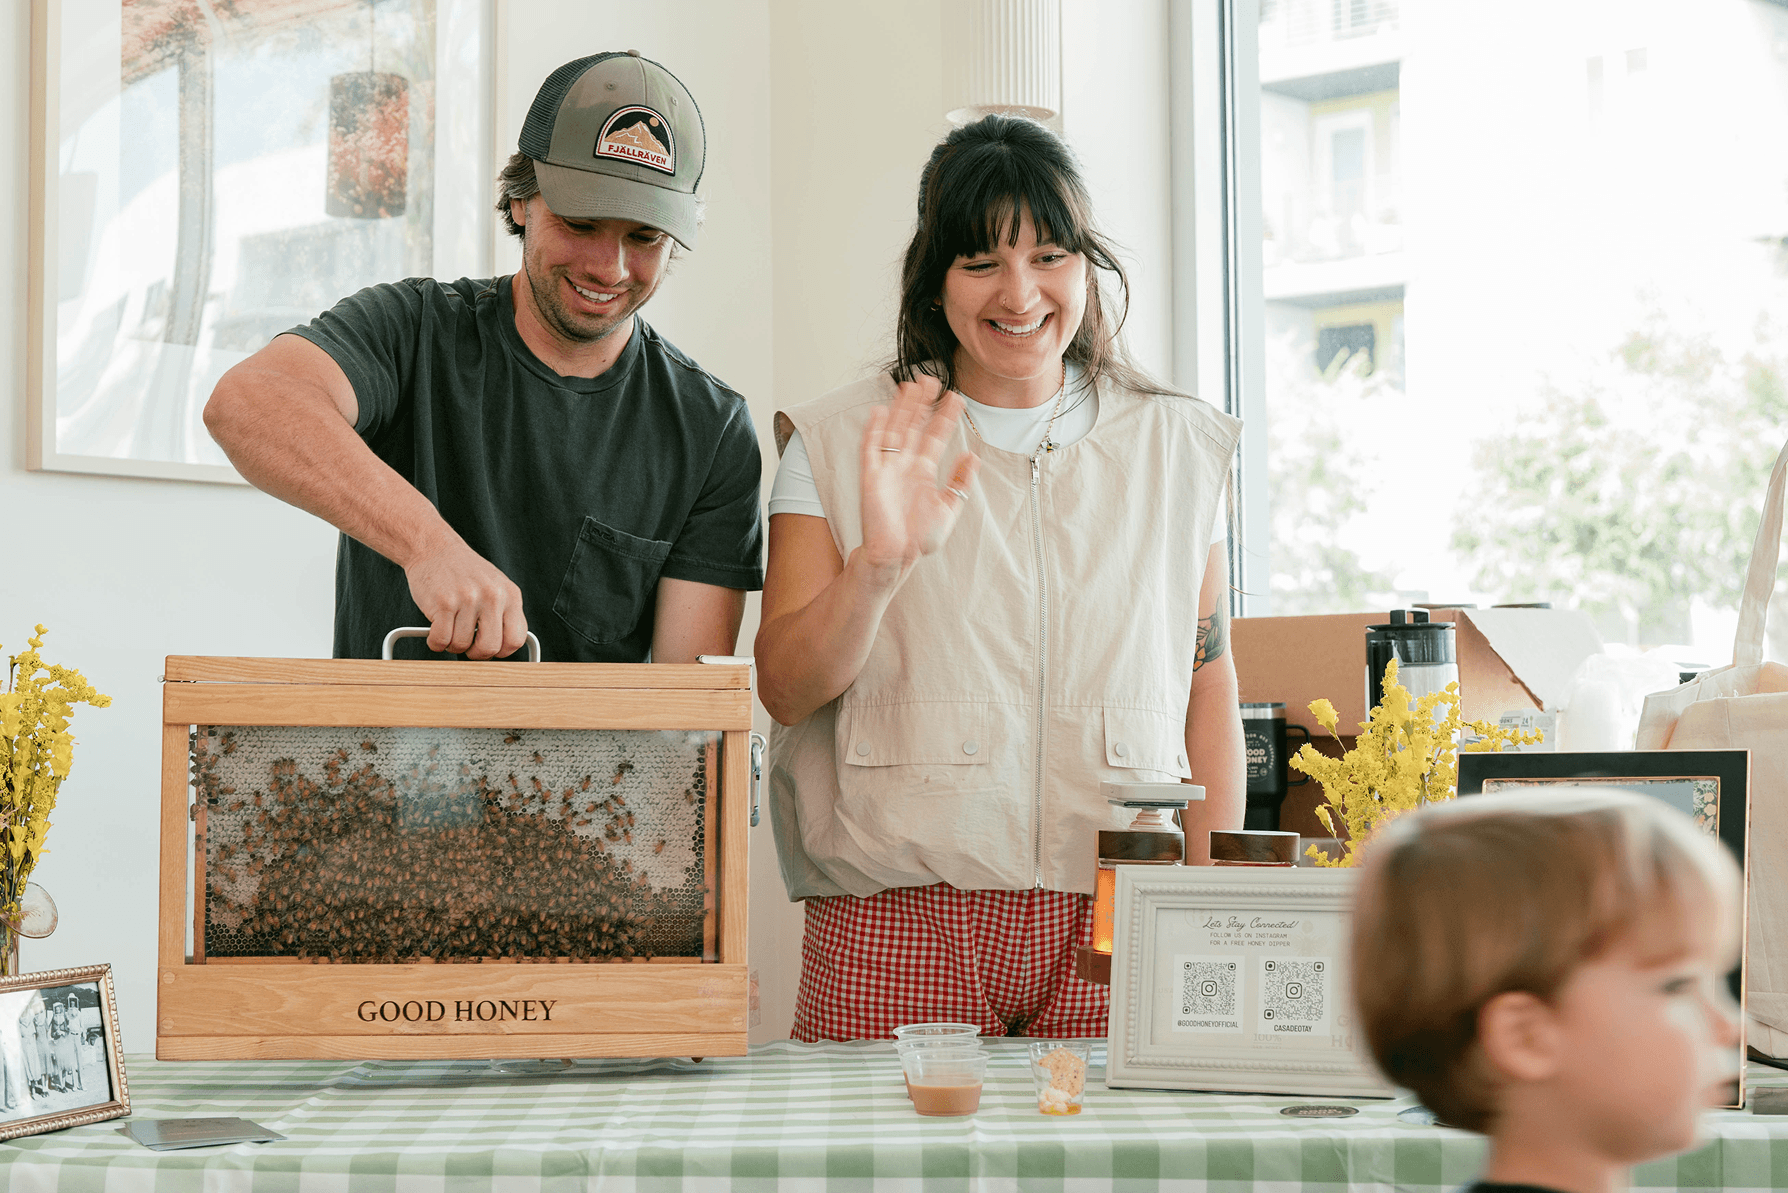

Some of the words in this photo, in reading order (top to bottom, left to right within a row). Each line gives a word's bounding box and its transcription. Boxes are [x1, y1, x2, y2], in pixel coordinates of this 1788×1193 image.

[608, 144, 667, 165] FJÄLLRÄVEN
[1246, 748, 1266, 757] OOD
[1246, 756, 1268, 764] ONEY
[1225, 915, 1246, 932] Stay
[1249, 916, 1300, 929] Connected!
[357, 1000, 446, 1022] GOOD
[454, 999, 558, 1022] HONEY
[1177, 1019, 1239, 1028] @GOODHONEYOFFICIAL
[1273, 1024, 1313, 1032] CASADEOTAY
